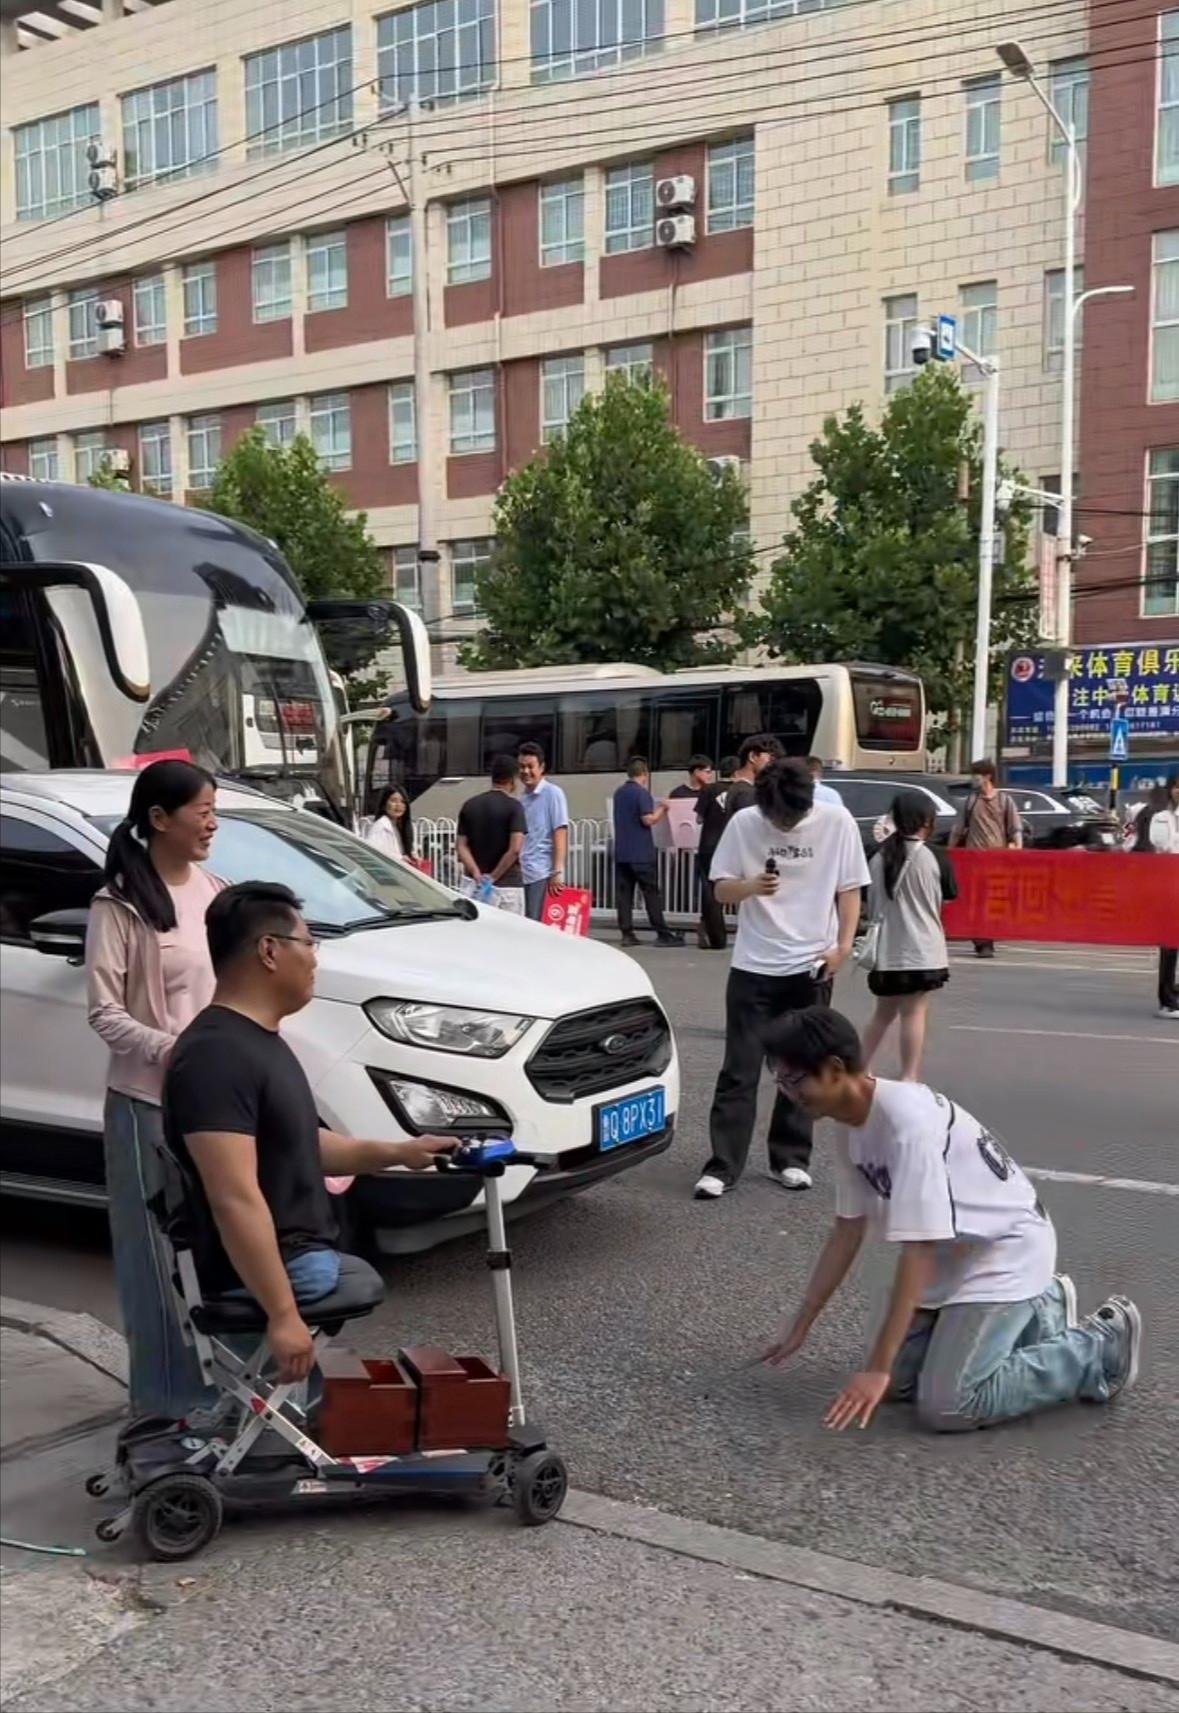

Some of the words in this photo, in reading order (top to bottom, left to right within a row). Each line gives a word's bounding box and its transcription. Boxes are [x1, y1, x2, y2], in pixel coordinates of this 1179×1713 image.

[1037, 649, 1179, 679] 来体育俱乐
[1072, 683, 1179, 707] 注中体育
